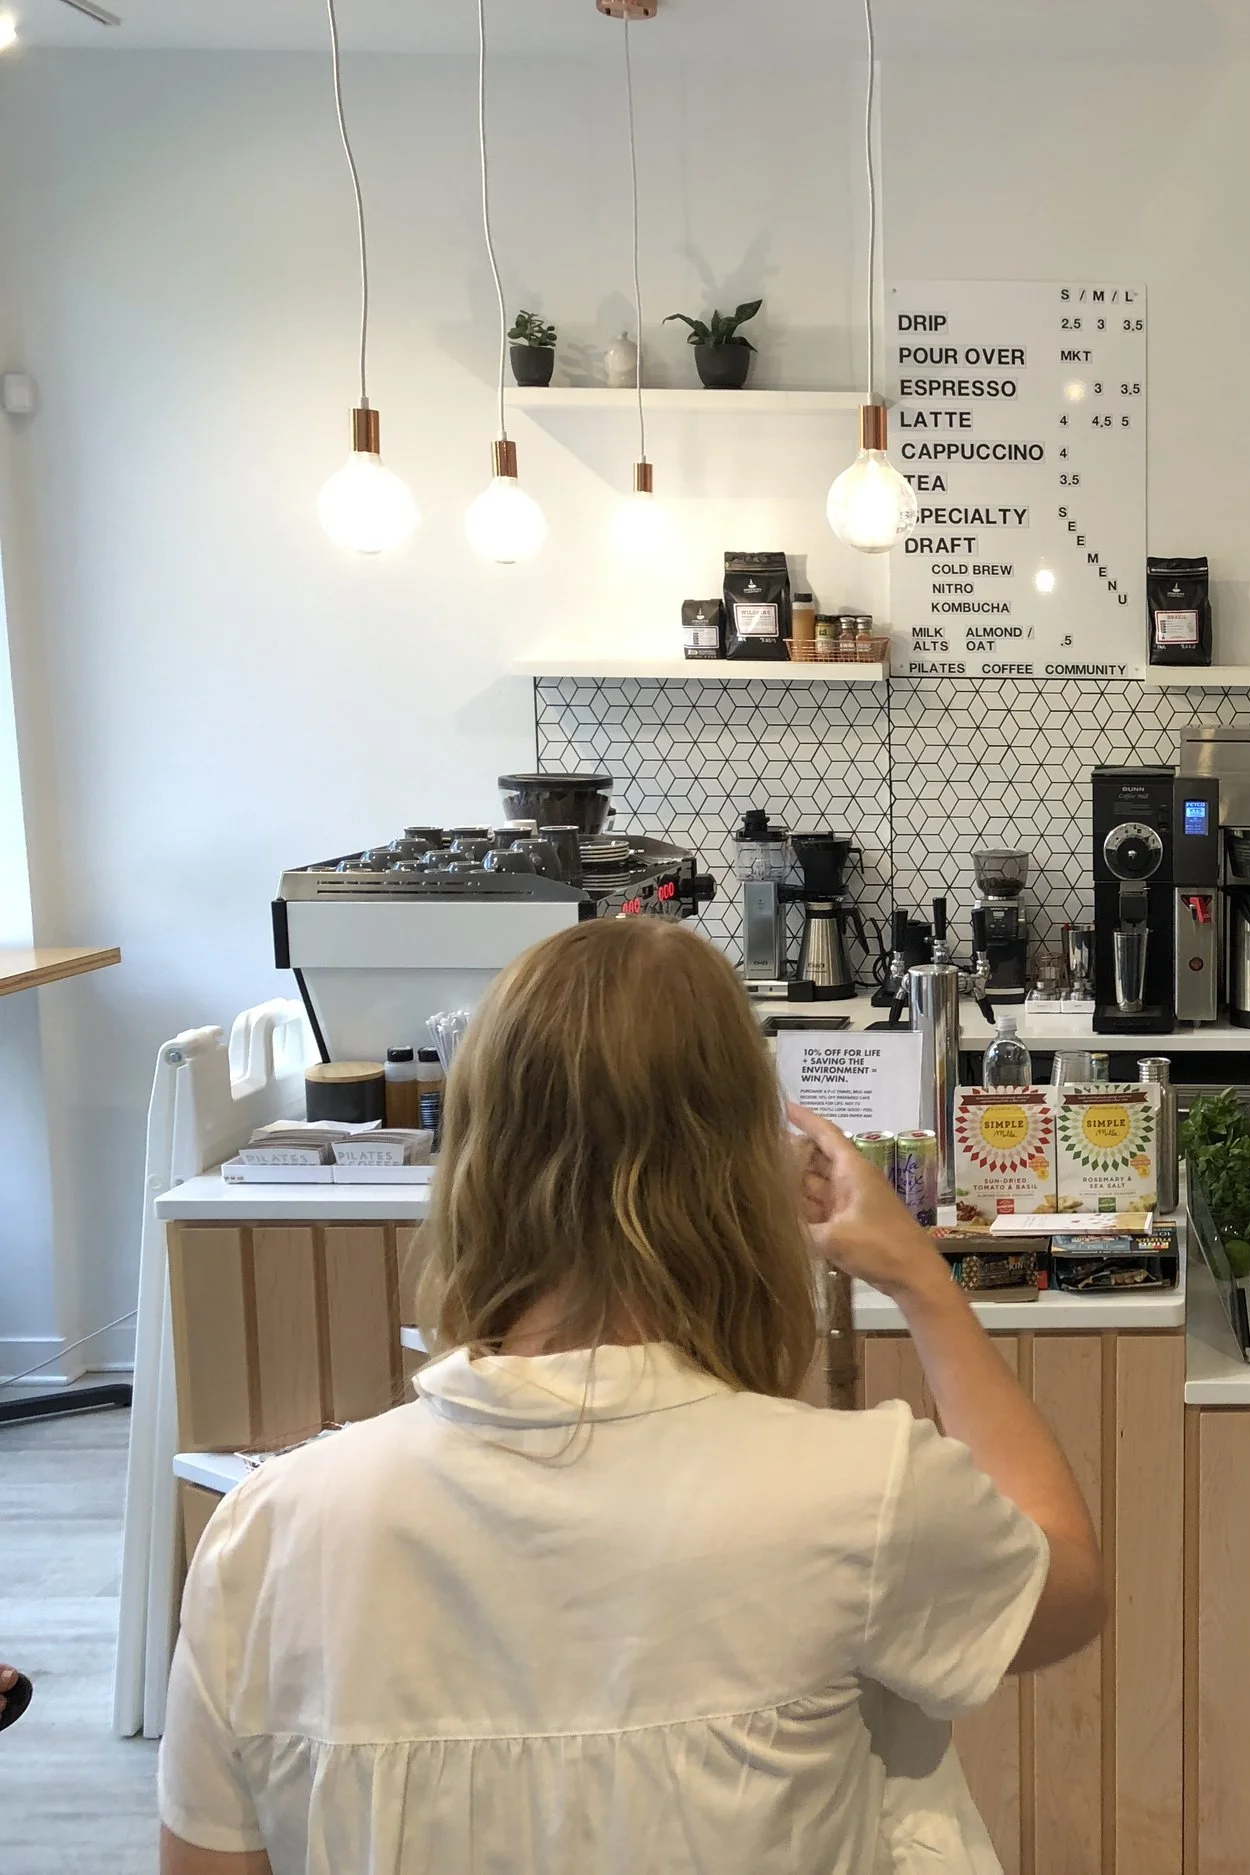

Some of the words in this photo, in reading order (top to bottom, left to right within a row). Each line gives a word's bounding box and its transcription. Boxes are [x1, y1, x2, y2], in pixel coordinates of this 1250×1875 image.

[1060, 288, 1070, 301] S
[1092, 290, 1105, 302] M
[1125, 291, 1133, 302] L
[898, 314, 947, 332] DRIP
[1061, 318, 1081, 330] 2.5
[1097, 318, 1105, 330] 3
[1123, 319, 1143, 332] 3.5
[899, 347, 958, 365] POUR
[964, 347, 1025, 366] OVER
[1060, 350, 1092, 362] MKT
[900, 379, 1017, 398] ESPRESSO
[1094, 382, 1102, 394] 3
[1120, 383, 1141, 396] 3.5
[900, 411, 972, 428] LATTE
[1059, 415, 1068, 426] 4
[1091, 415, 1112, 428] 4.5
[1121, 416, 1129, 427] 5
[901, 442, 1044, 461] CAPPUCCINO
[1059, 448, 1068, 459] 4
[902, 474, 946, 492] TEA
[1059, 474, 1080, 486] 3.5
[915, 507, 1028, 526] PECIALTY
[904, 537, 976, 554] DRAFT
[931, 564, 968, 575] COLD
[972, 564, 1013, 576] BREW
[932, 583, 974, 594] NITRO
[931, 602, 1010, 613] KOMBUCHA
[912, 627, 944, 638] MILK
[965, 627, 1023, 638] ALMOND
[912, 640, 949, 652] ALTS
[966, 640, 995, 652] OAT
[1060, 635, 1072, 647] .5
[909, 662, 966, 674] PILATES
[981, 663, 1033, 675] COFFEE
[1045, 664, 1126, 675] COMMUNITY
[803, 1048, 822, 1057] 10%
[824, 1049, 842, 1057] OFF
[843, 1049, 862, 1057] FOR
[864, 1049, 881, 1057] LIFE
[810, 1057, 846, 1065] SAVING
[848, 1057, 865, 1066] THE
[801, 1066, 870, 1074] ENVIRONMENT
[801, 1074, 849, 1084] WIN/WIN.
[984, 1120, 1024, 1129] SIMPLE
[1086, 1119, 1126, 1128] SIMPLE
[245, 1153, 309, 1164] PILATES
[338, 1151, 393, 1161] PILATES
